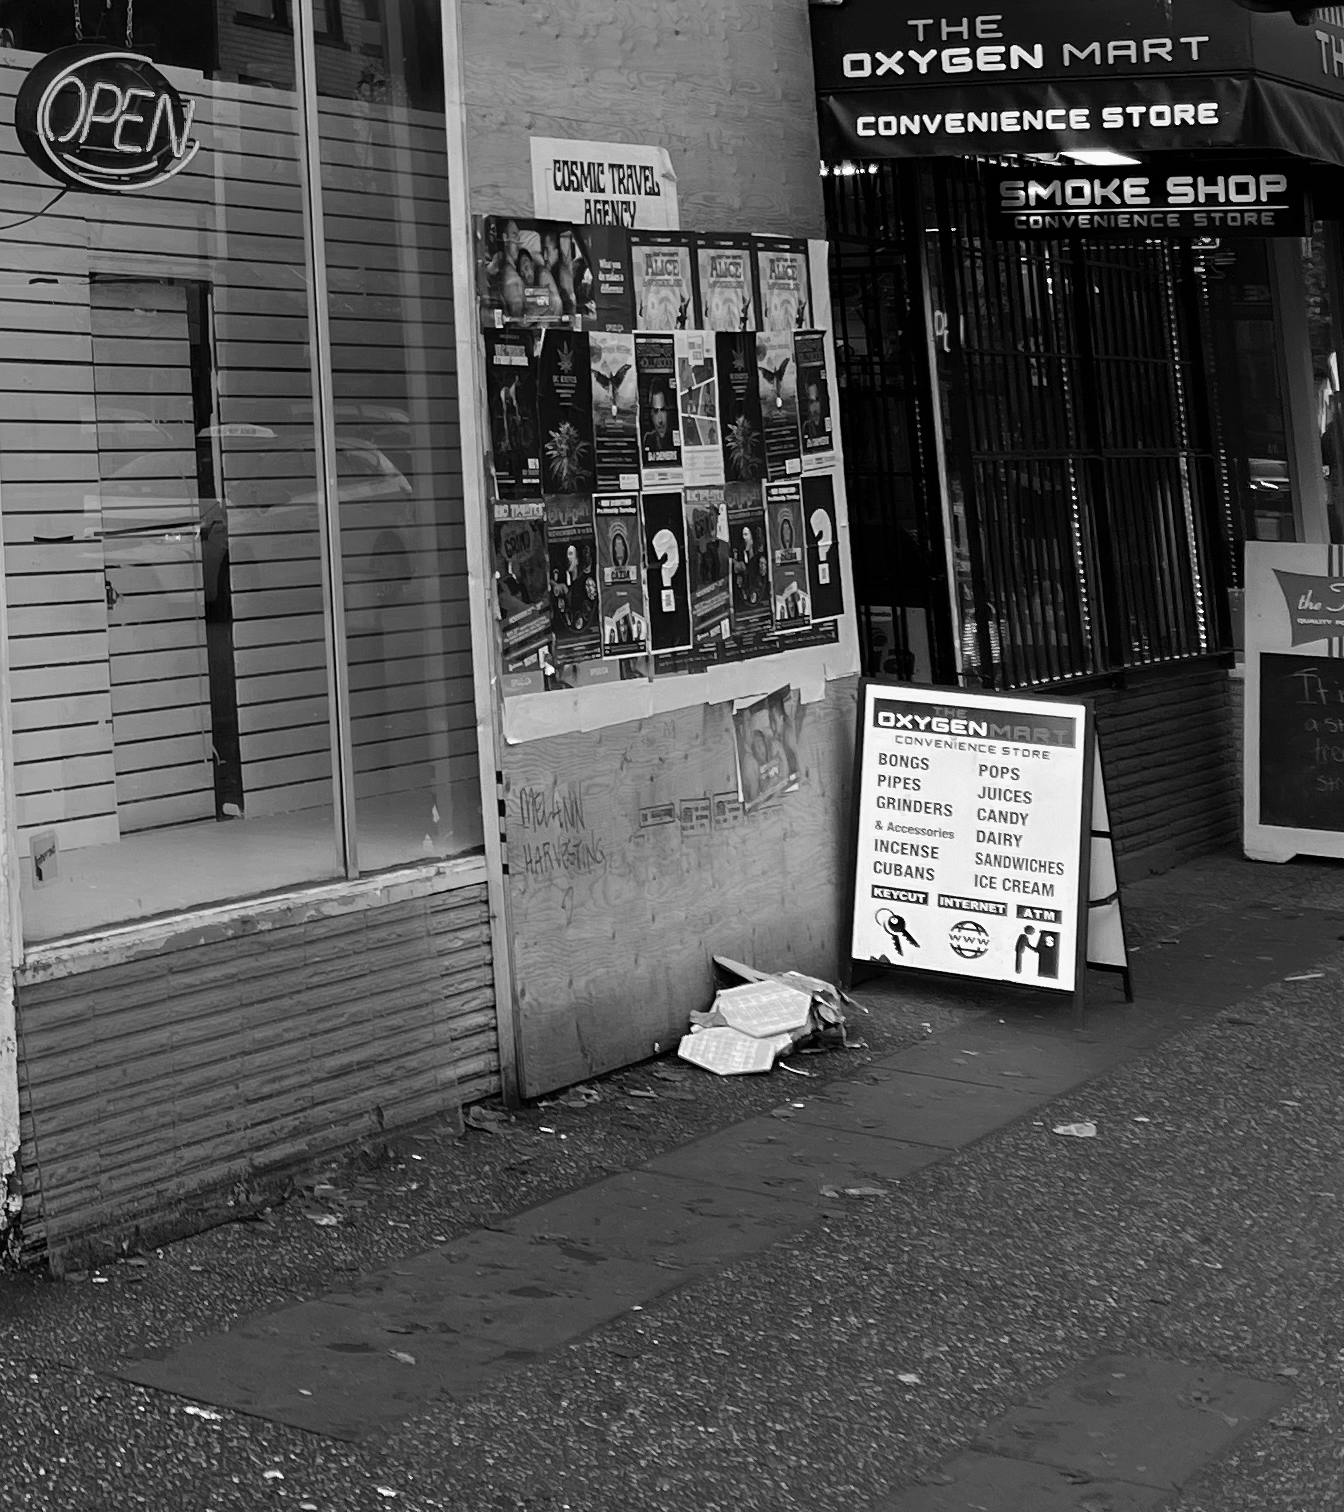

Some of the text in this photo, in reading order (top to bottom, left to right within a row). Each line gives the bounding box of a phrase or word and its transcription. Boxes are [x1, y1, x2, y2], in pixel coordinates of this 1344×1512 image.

[907, 14, 1004, 42] THE
[842, 35, 1210, 79] OXYGEN MART
[42, 74, 196, 158] OPEN
[856, 102, 1220, 137] CONVENIENCE STORE
[552, 159, 661, 196] COSMIC TRAVEL
[999, 173, 1288, 207] SMOKE SHOP
[584, 198, 637, 228] AGENCY
[1013, 212, 1276, 230] CONVENIENCE STORE
[1297, 589, 1322, 611] the
[877, 711, 1070, 746] OXYGEN MART
[895, 734, 1051, 760] CONVENIENCE STORE
[878, 752, 930, 771] BONGS
[877, 774, 922, 792] PIPES
[978, 764, 1021, 782] POPS
[977, 786, 1033, 805] JUICES
[876, 795, 953, 818] GRINDERS
[976, 808, 1029, 827] CANDY
[875, 820, 955, 840] & Accessories
[976, 830, 1023, 848] DAIRY
[873, 839, 940, 860] INCENSE
[873, 861, 935, 881] CUBANS
[974, 852, 1065, 876] SANDWICHES
[873, 888, 927, 905] KEYCUT
[973, 874, 1055, 898] ICE CREAM
[939, 895, 1007, 915] INTERNET
[1023, 907, 1056, 922] ATM
